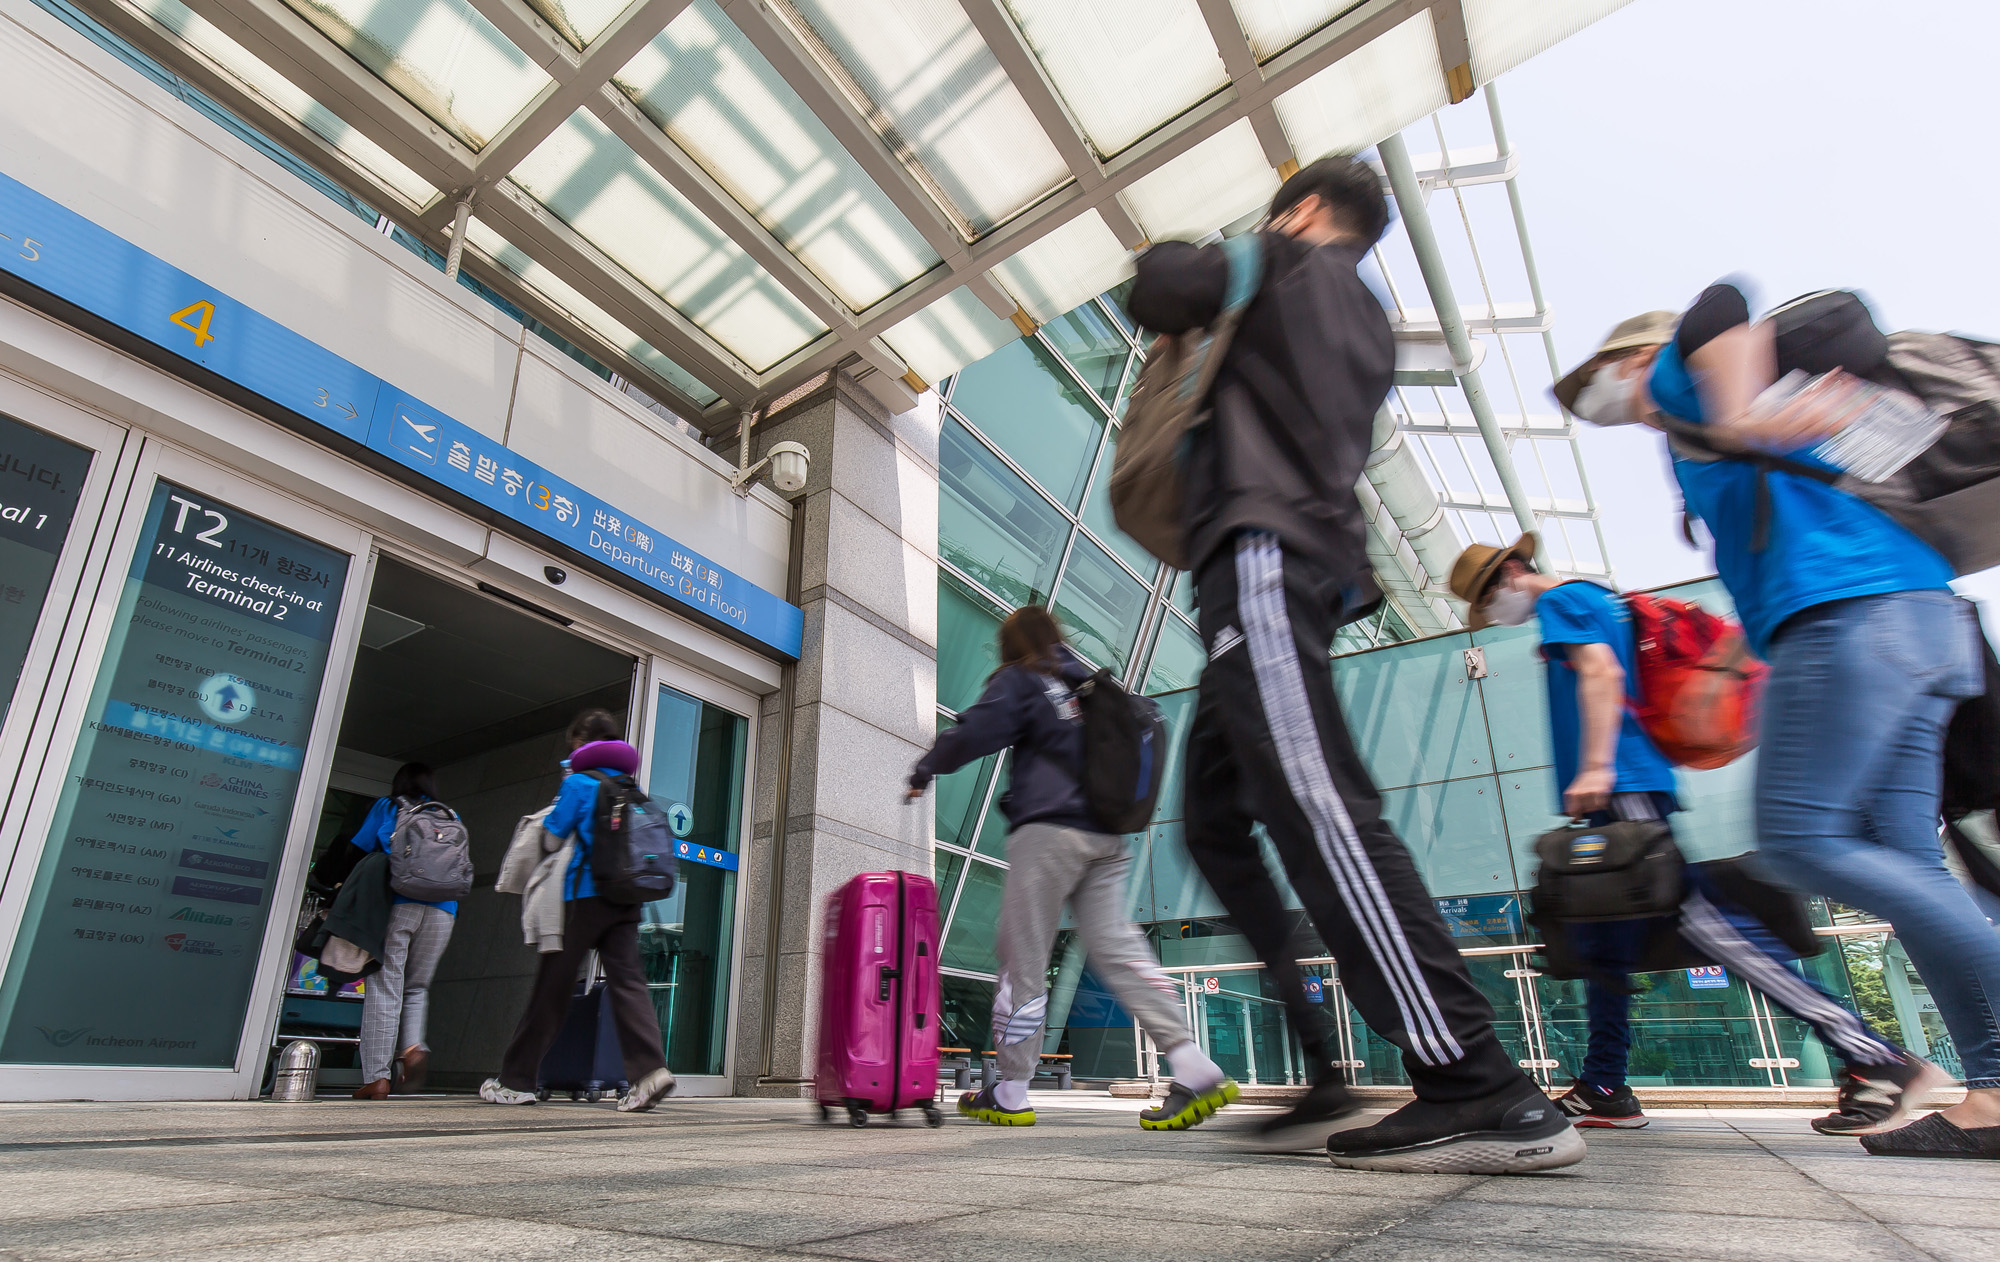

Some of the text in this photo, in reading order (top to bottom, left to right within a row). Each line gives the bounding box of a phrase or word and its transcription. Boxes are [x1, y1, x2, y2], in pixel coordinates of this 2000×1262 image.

[19, 237, 43, 262] 5
[168, 299, 216, 348] 4
[313, 387, 330, 408] 3
[0, 502, 48, 530] al 1
[171, 495, 229, 549] T2
[228, 539, 331, 589] 11개 항공사
[177, 551, 239, 583] Airlines
[240, 575, 305, 606] check-in
[306, 599, 324, 613] at
[589, 531, 748, 625] Departures (3rd Floor)
[186, 572, 288, 621] Terminal 2
[137, 596, 199, 625] Following
[246, 632, 310, 660] passengers,
[130, 614, 307, 675] please move to Terminal 2.
[155, 653, 215, 677] 대한항공 (KE)
[188, 690, 209, 702] (DL)
[228, 675, 294, 699] KOREAN AIR
[130, 701, 203, 728] 에어프랑스 (AF)
[239, 704, 284, 723] DELTA
[213, 724, 278, 744] AIRFRANCE
[175, 741, 195, 753] (KL)
[129, 758, 189, 779] 중화항공 (CI)
[223, 757, 253, 769] KLM
[75, 776, 182, 805] 가루다인도네시아 (GA)
[219, 783, 269, 799] AIRLINES
[228, 776, 263, 790] CHINA
[150, 820, 175, 832] (MF)
[140, 847, 167, 859] (AM)
[137, 875, 160, 887] (SU)
[128, 903, 152, 916] (AZ)
[168, 907, 234, 926] Alitalia
[1440, 906, 1467, 914] Arrivals
[73, 928, 144, 945] 체코항공 (OK)
[185, 939, 215, 948] CZECH
[86, 1035, 197, 1050] Incheon Airport
